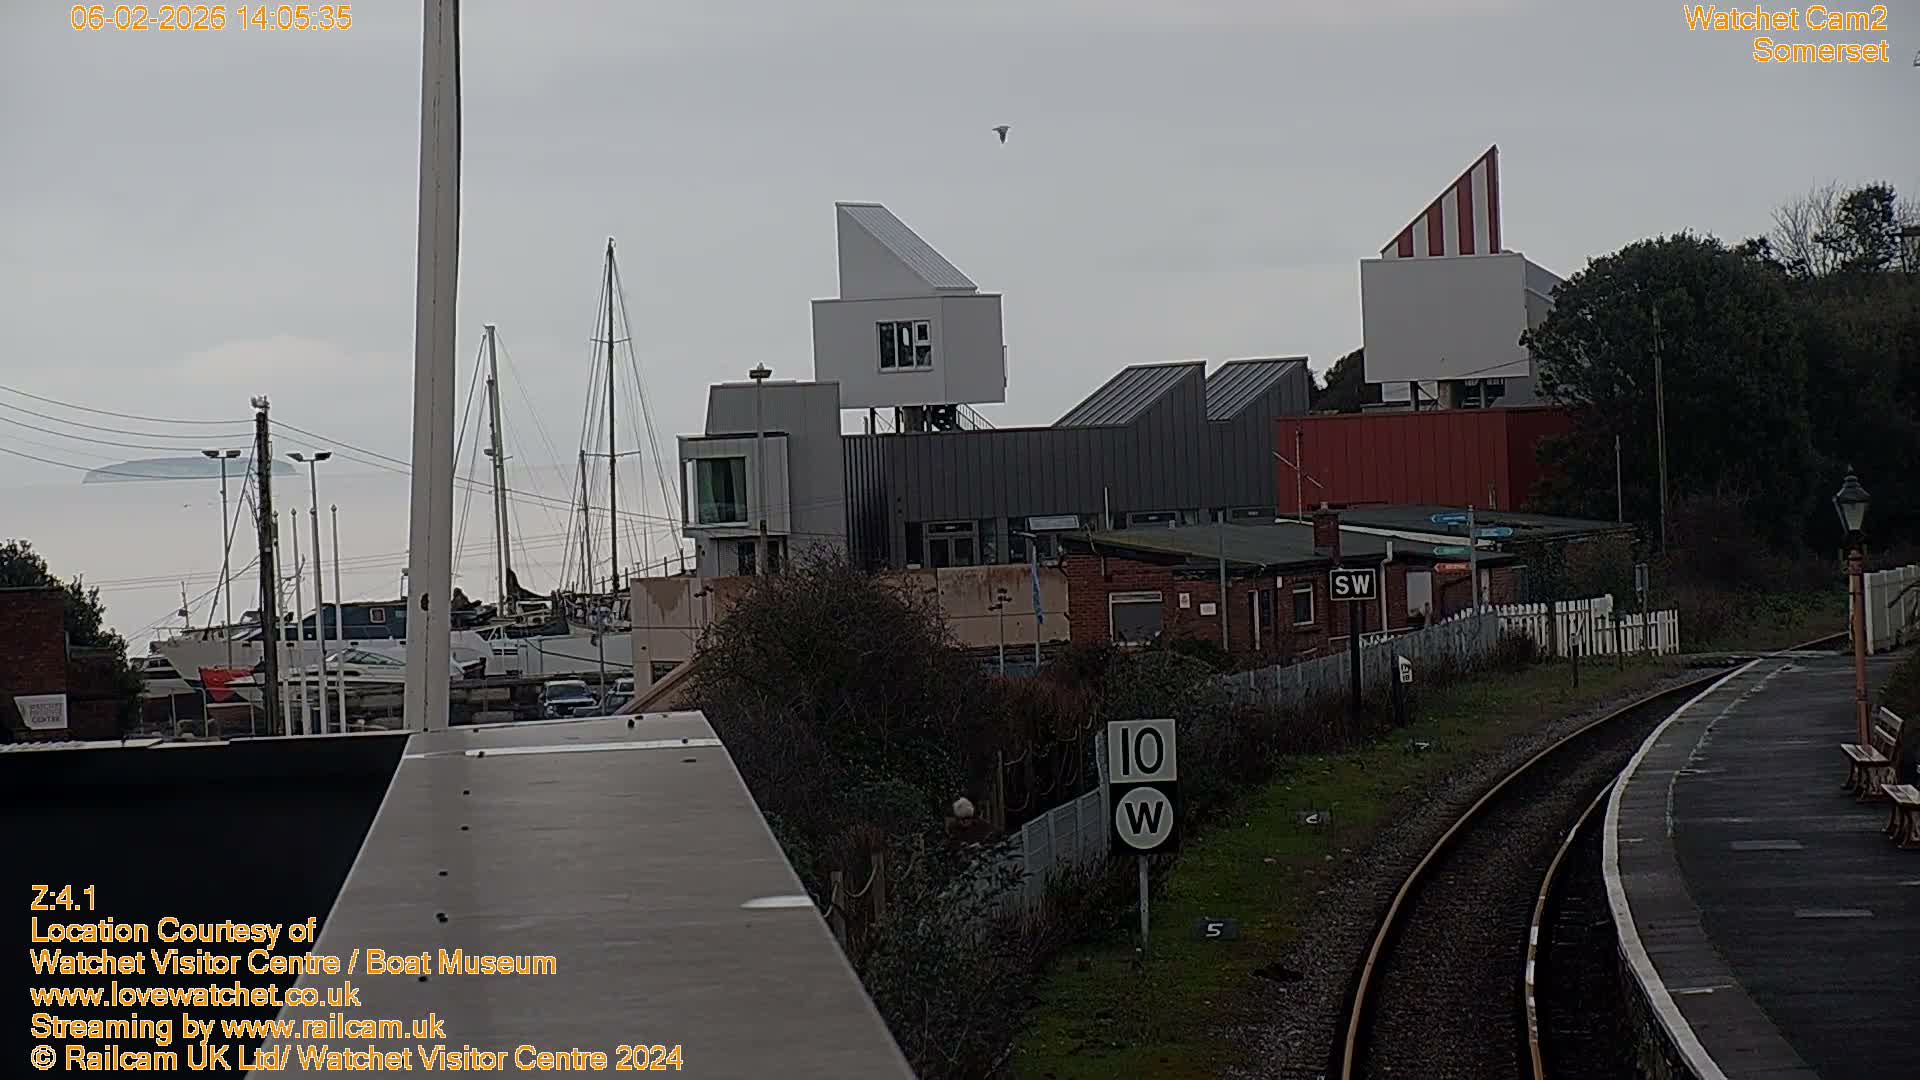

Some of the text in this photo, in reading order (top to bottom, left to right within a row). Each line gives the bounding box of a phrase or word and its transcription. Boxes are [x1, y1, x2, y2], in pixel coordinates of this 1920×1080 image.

[1335, 575, 1370, 595] SW
[1121, 727, 1164, 776] 10
[1124, 801, 1164, 835] W
[1206, 922, 1224, 937] 5
